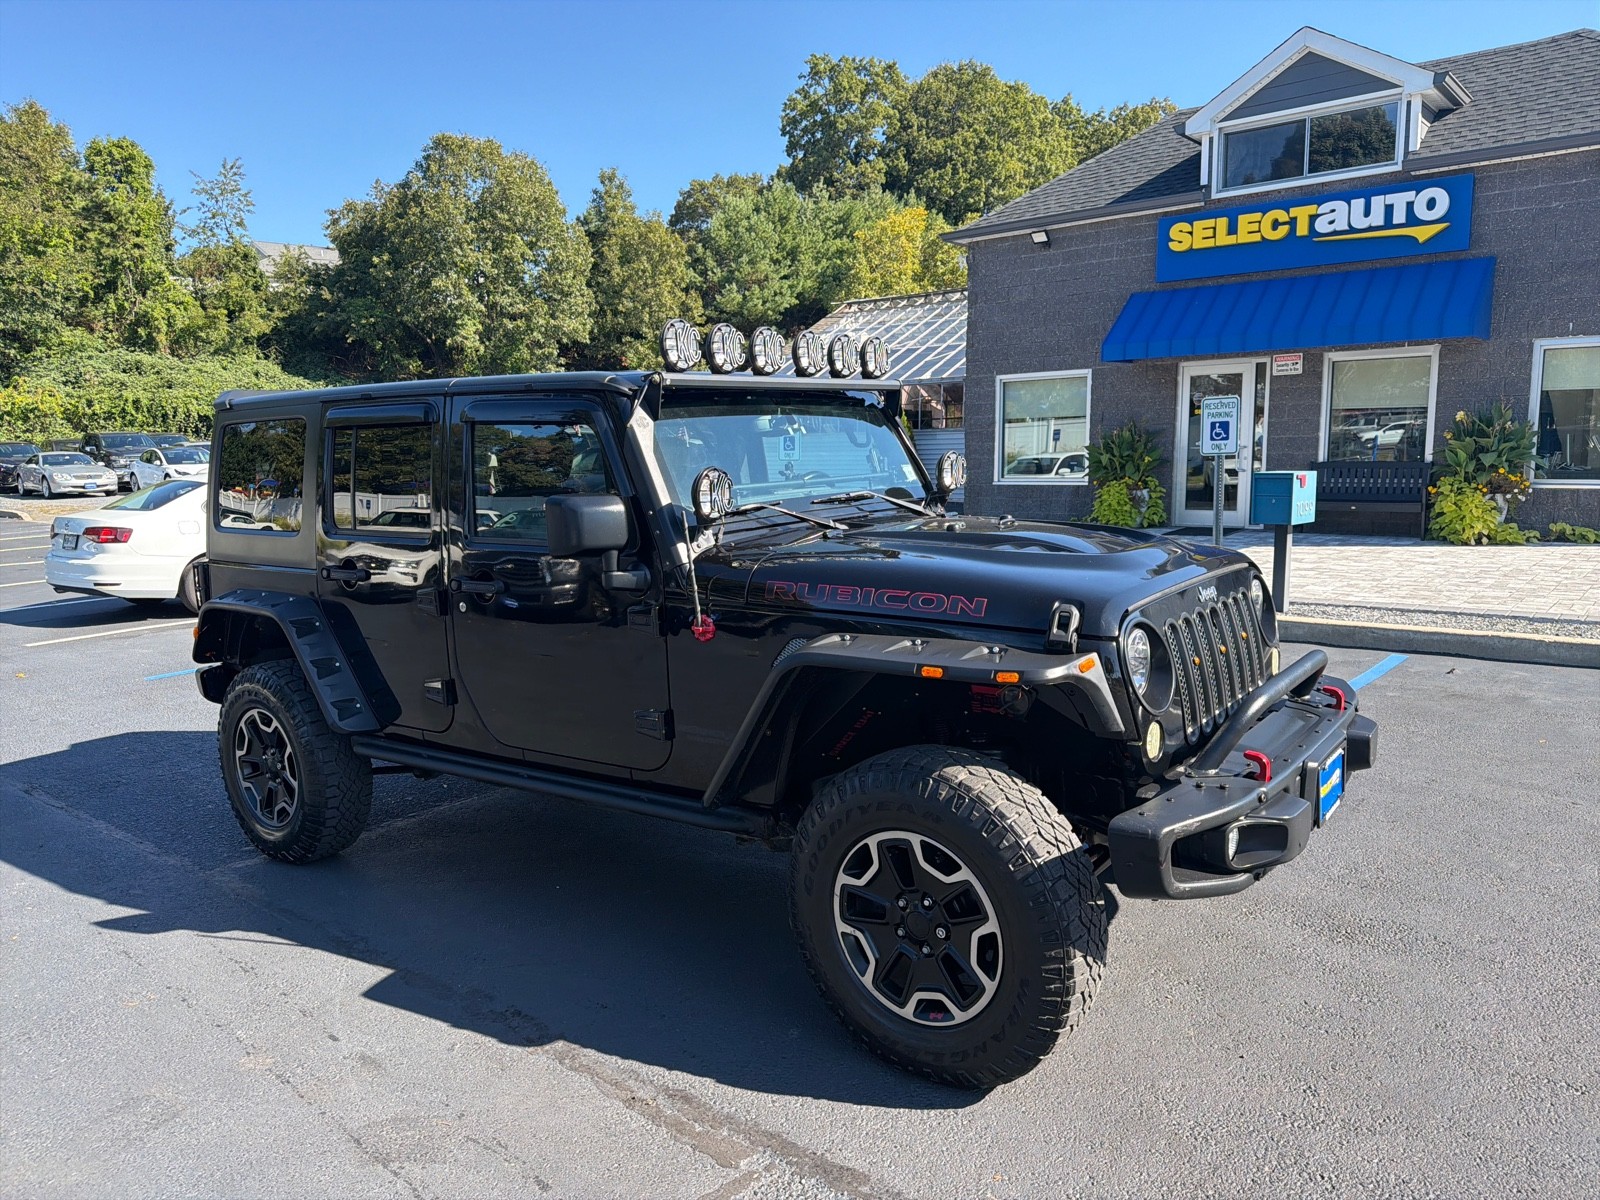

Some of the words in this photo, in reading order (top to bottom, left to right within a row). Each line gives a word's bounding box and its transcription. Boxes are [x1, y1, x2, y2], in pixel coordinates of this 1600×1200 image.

[677, 323, 702, 367] KC
[723, 328, 746, 367] KC
[765, 331, 786, 369] KC
[1204, 401, 1236, 411] RESERVED
[1207, 411, 1234, 419] PARKING
[1211, 442, 1228, 451] ONLY
[712, 474, 735, 515] KC
[764, 580, 988, 618] RUBICON
[1196, 585, 1218, 603] Jeep
